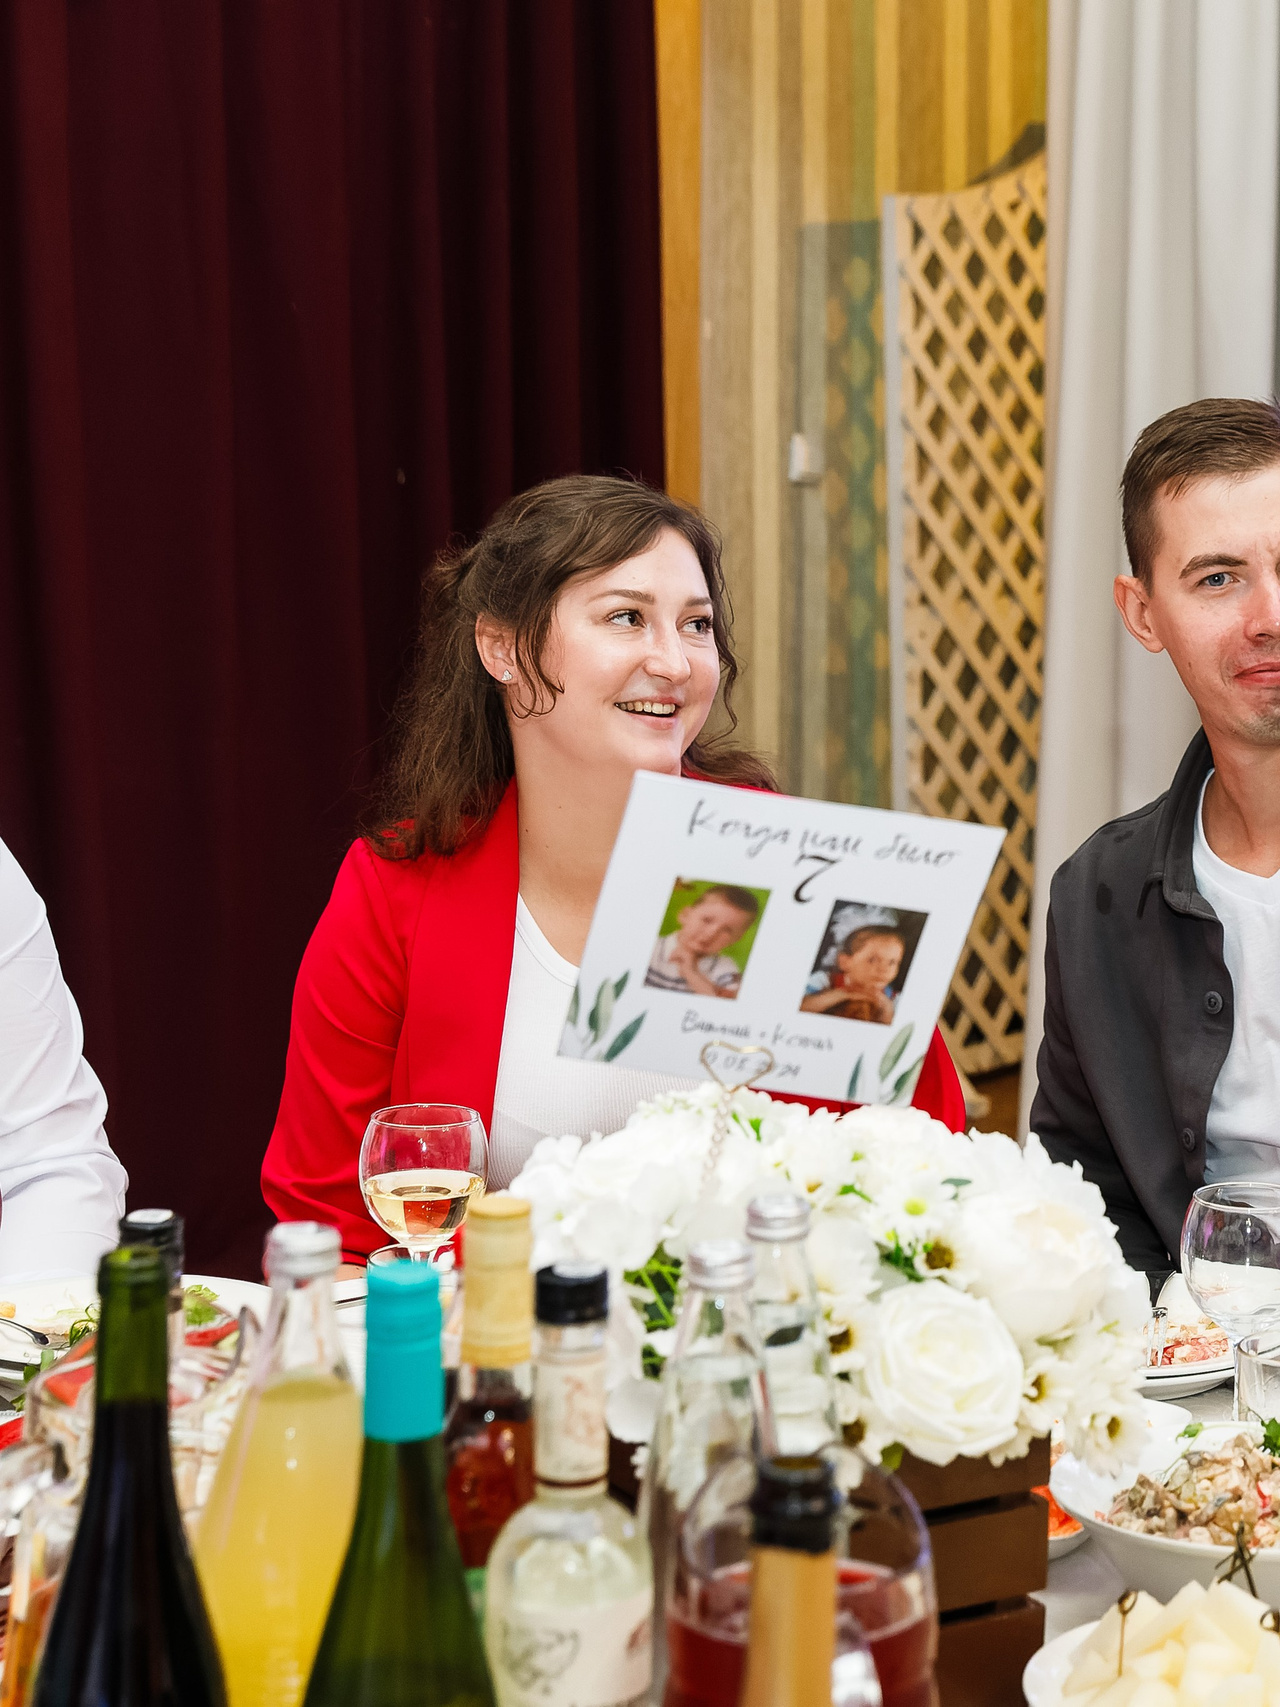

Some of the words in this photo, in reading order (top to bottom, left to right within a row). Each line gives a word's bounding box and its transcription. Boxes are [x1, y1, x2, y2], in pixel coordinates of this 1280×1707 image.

[687, 798, 791, 859] Когда
[797, 828, 865, 857] нам
[874, 833, 961, 867] было
[794, 853, 844, 903] 7
